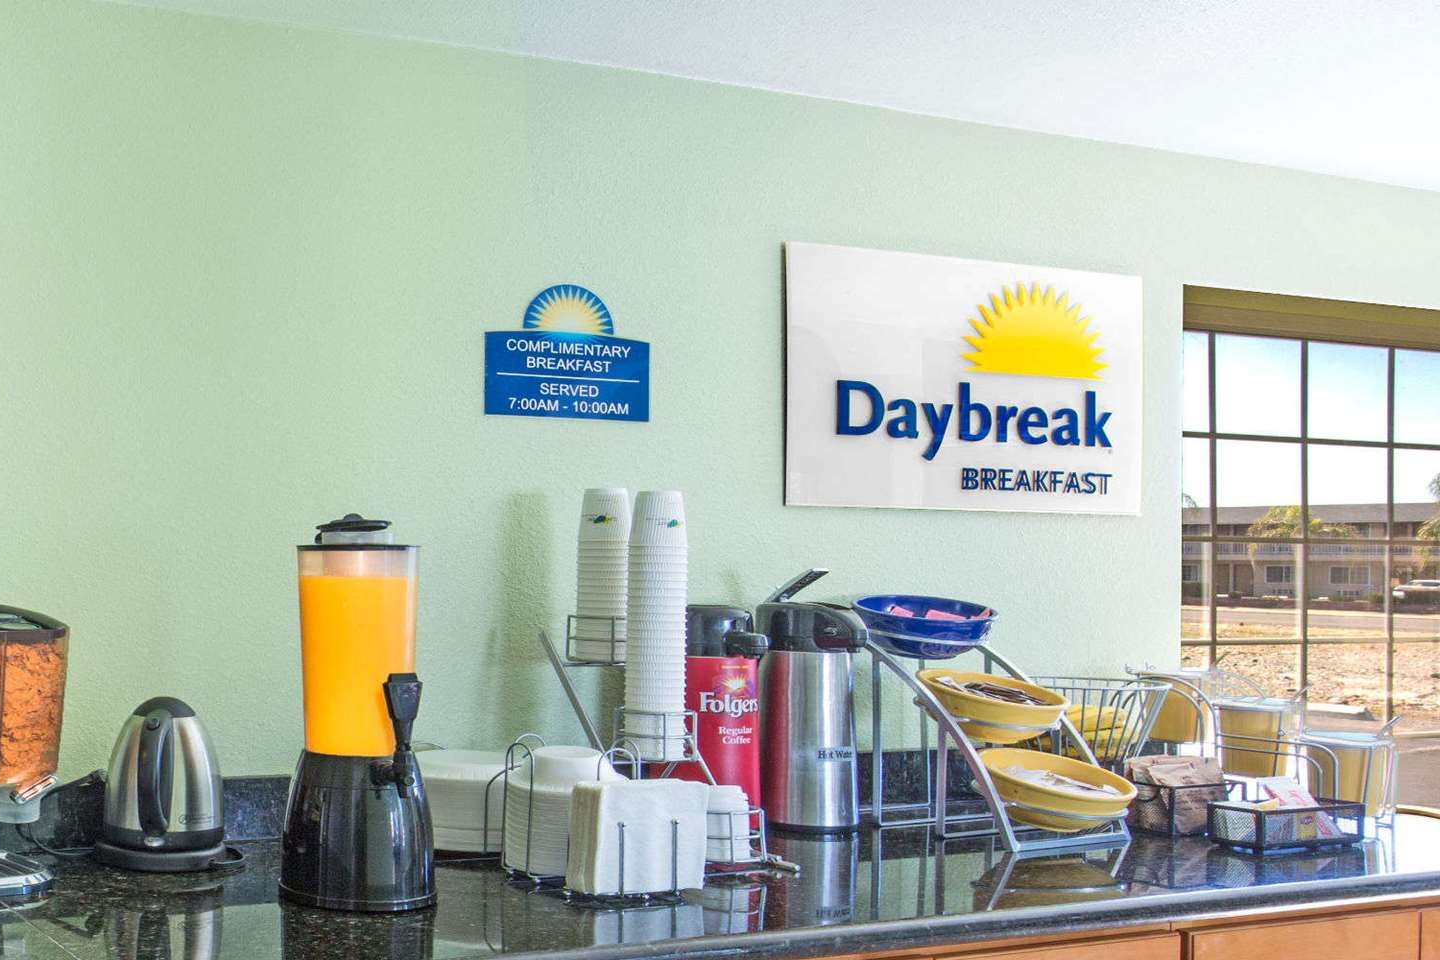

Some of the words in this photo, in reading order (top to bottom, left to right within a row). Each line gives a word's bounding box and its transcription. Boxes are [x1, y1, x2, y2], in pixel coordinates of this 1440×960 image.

[506, 339, 631, 358] COMPLIMENTARY
[526, 356, 612, 373] BREAKFAST
[539, 382, 599, 398] SERVED
[508, 397, 559, 412] 7:00AM
[572, 400, 629, 415] 10:00AM
[836, 379, 1113, 461] Daybreak
[961, 467, 1113, 495] BREAKFAST
[699, 691, 759, 718] Folgers
[718, 726, 753, 736] Regular
[722, 735, 752, 745] Coffee
